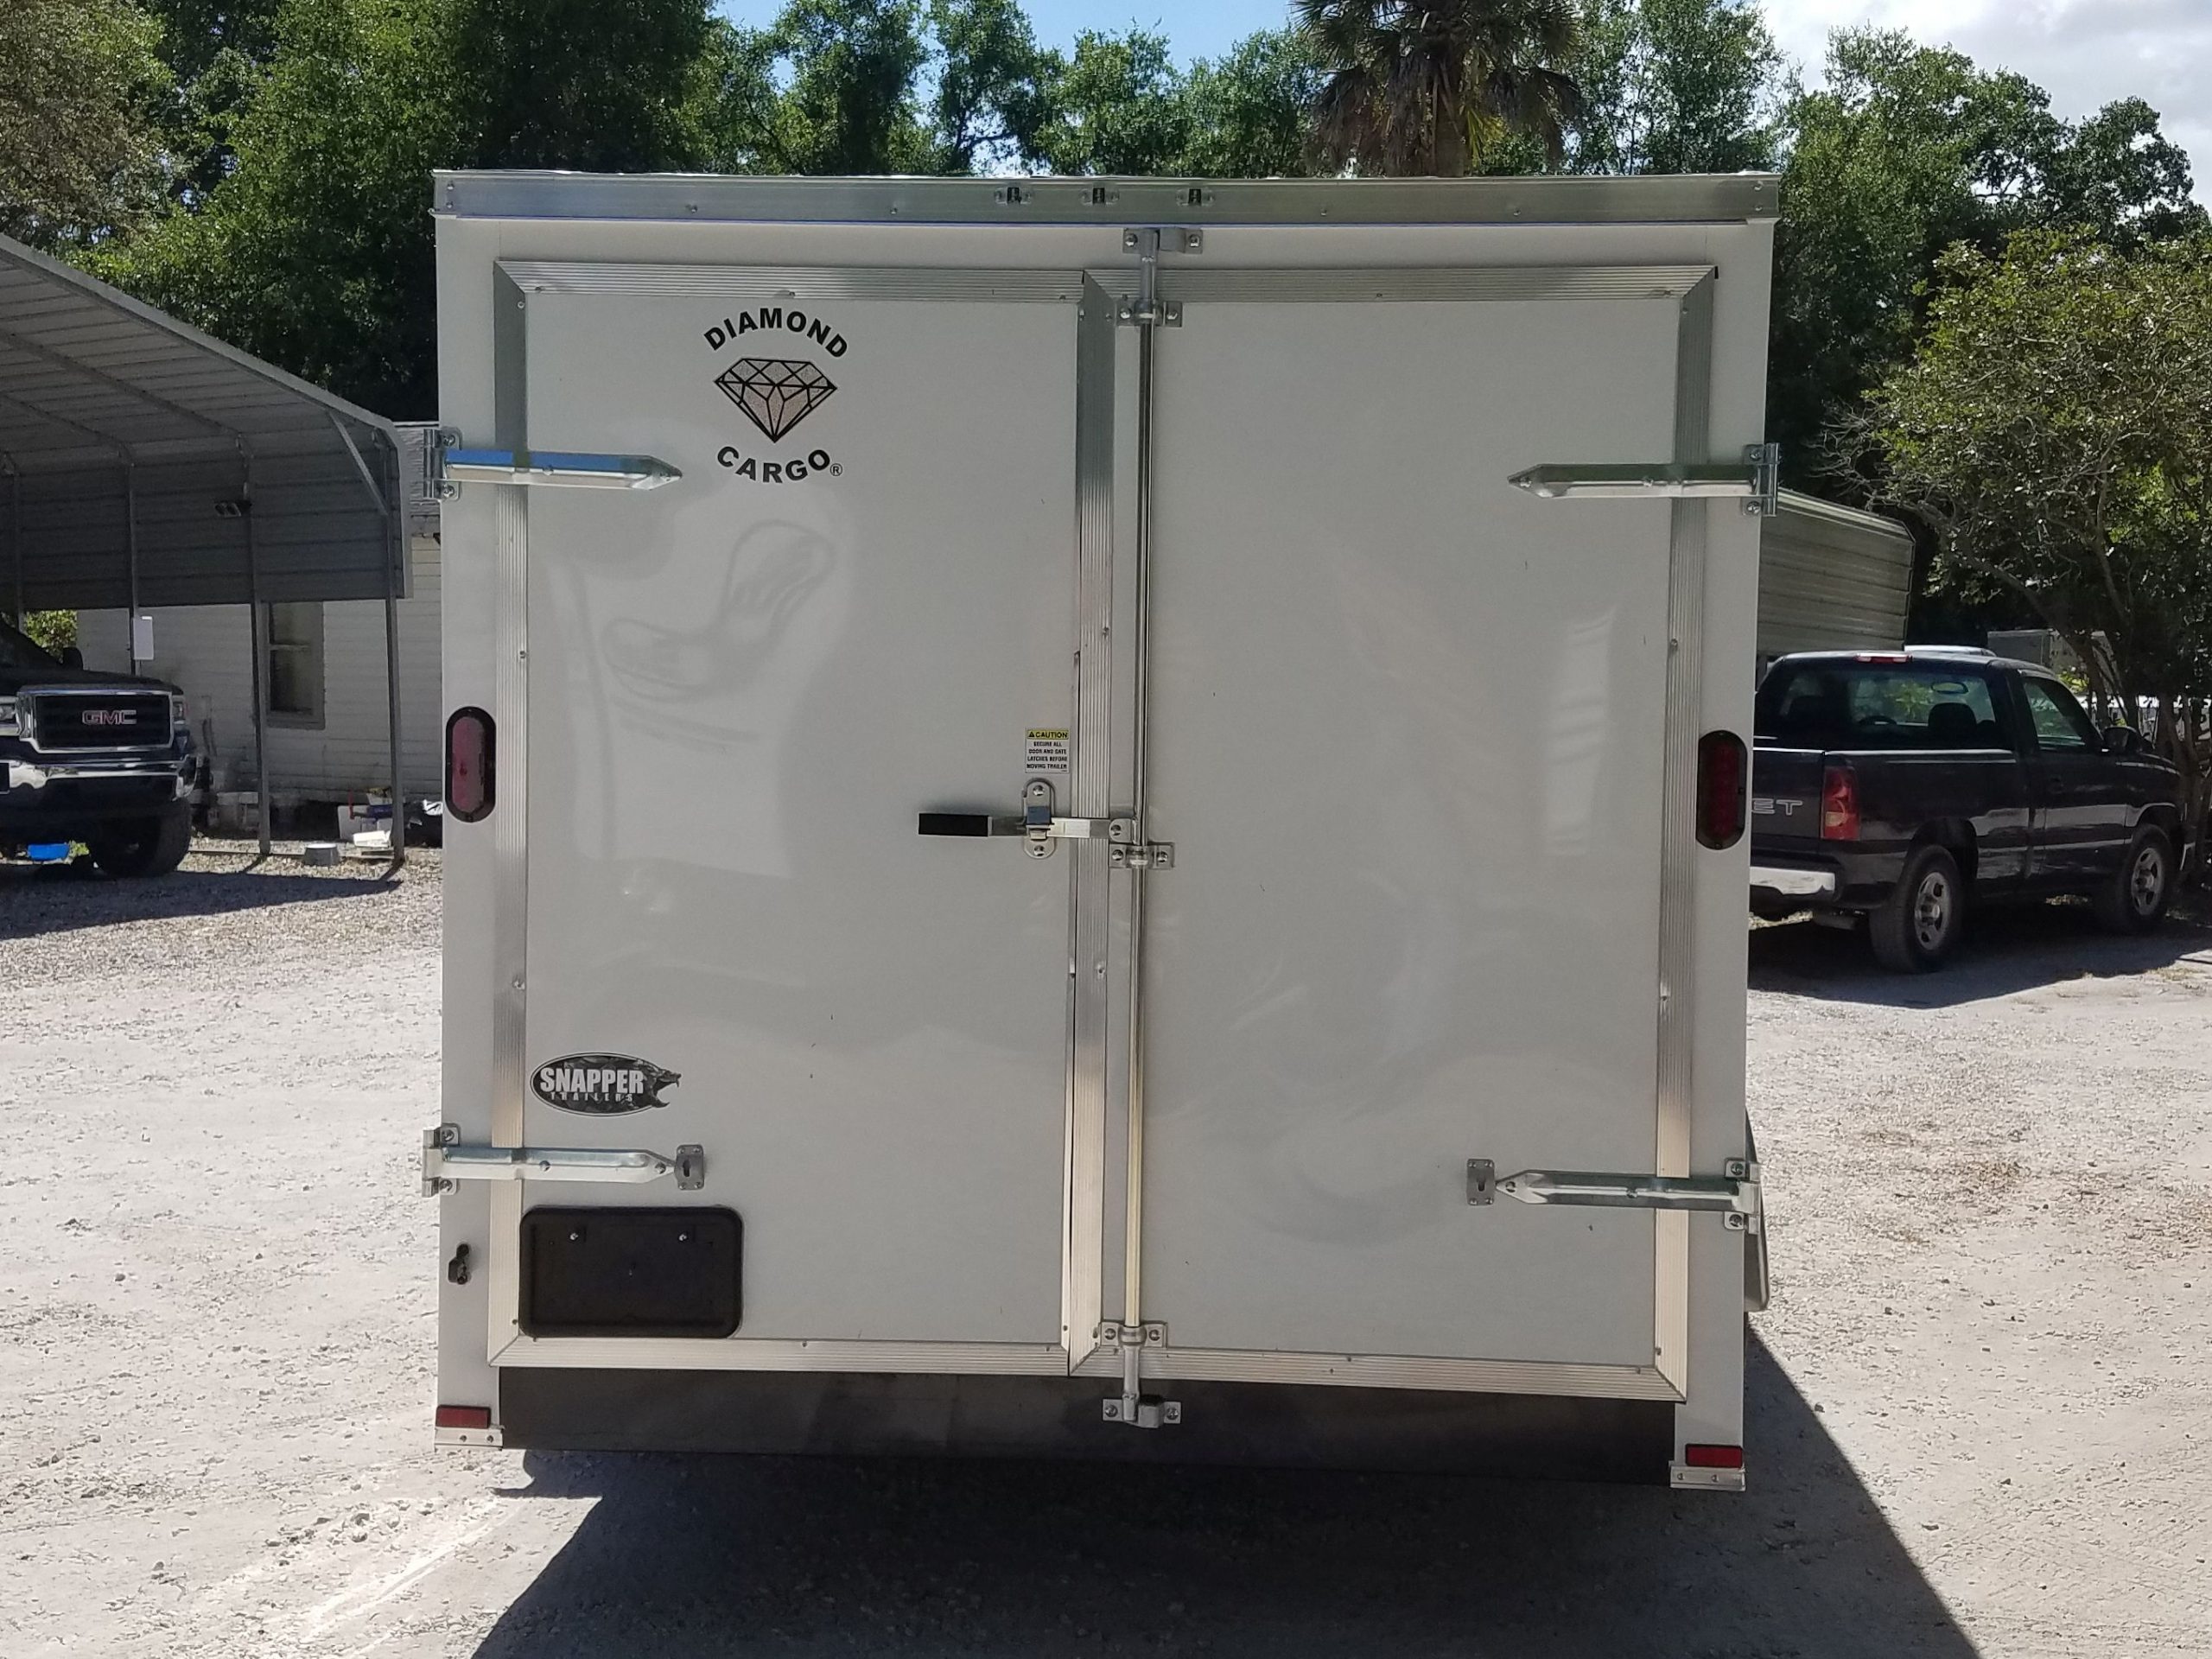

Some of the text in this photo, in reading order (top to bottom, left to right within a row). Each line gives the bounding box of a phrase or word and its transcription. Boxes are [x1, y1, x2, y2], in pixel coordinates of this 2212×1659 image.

[703, 308, 848, 358] DIAMOND
[82, 709, 137, 725] GMC
[539, 1067, 644, 1094] SNAPPER
[550, 1092, 633, 1102] TRAILERS
